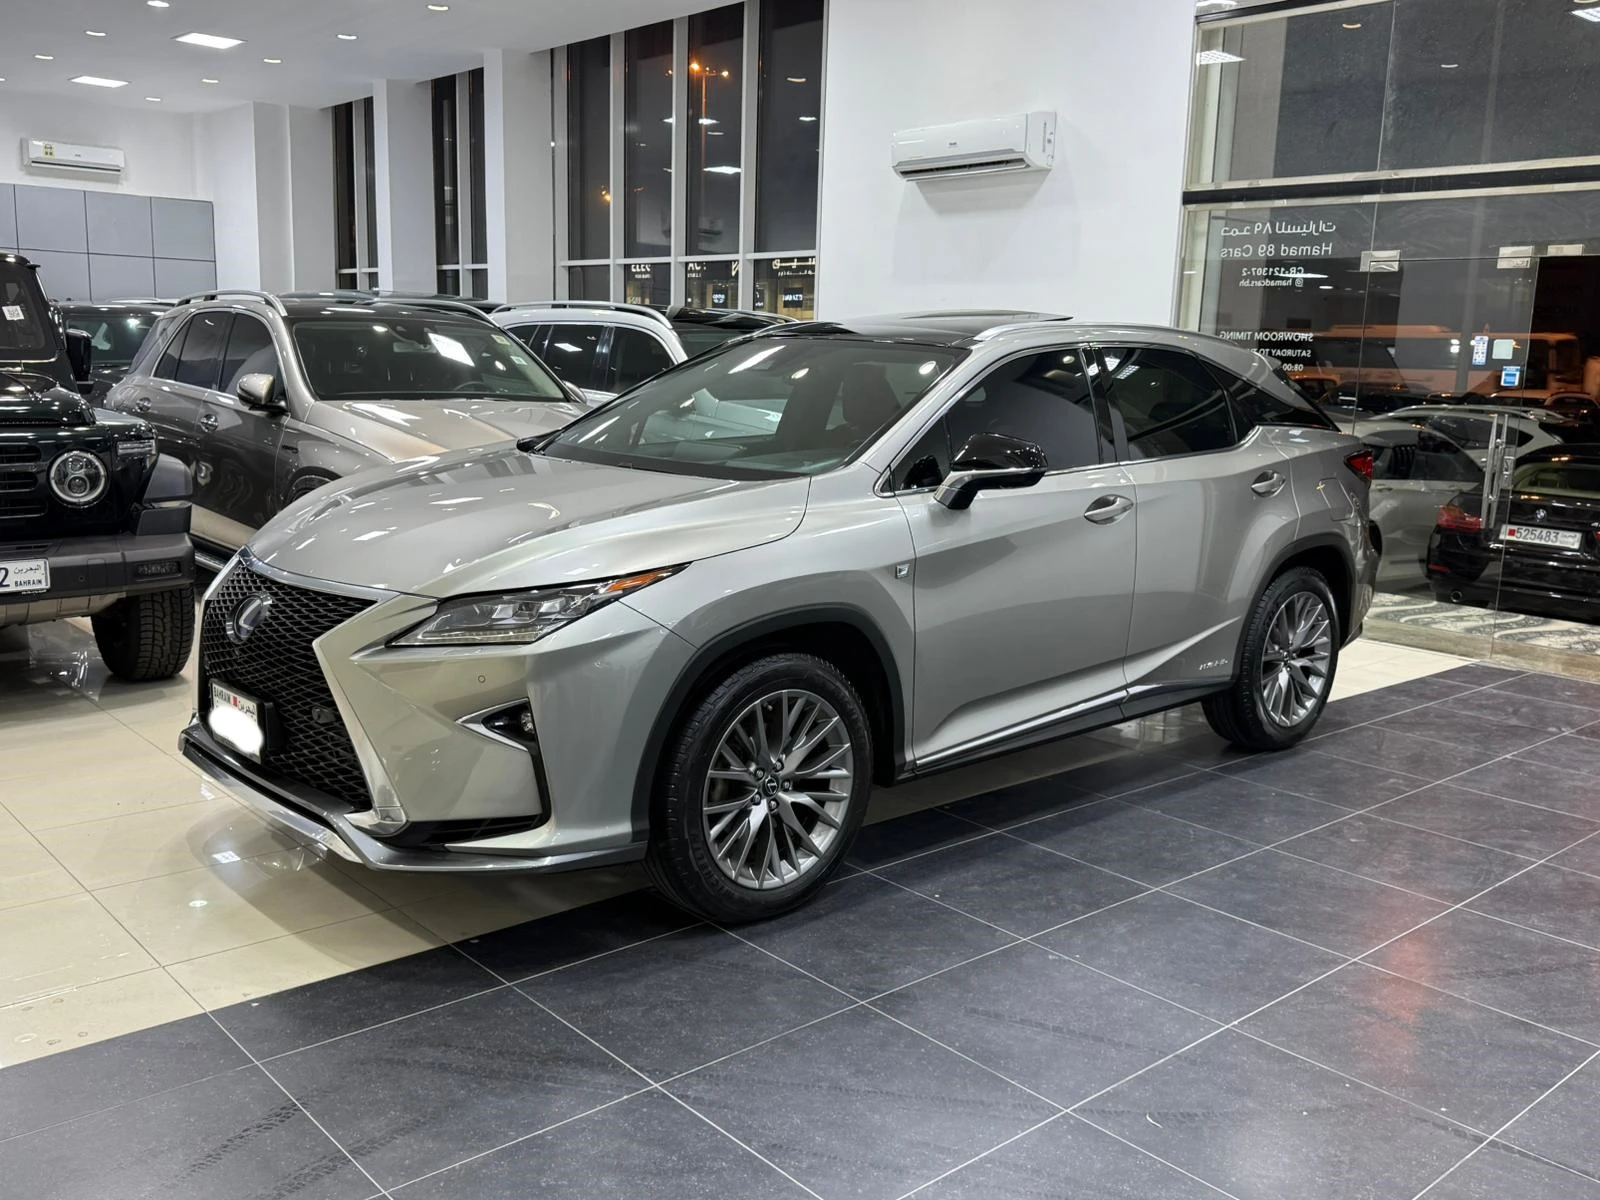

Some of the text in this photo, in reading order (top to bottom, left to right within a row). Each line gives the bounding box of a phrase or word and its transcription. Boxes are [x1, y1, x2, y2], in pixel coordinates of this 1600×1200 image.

[1515, 527, 1560, 544] 525483
[13, 564, 42, 575] البحرين
[14, 578, 43, 588] BAHRAIN
